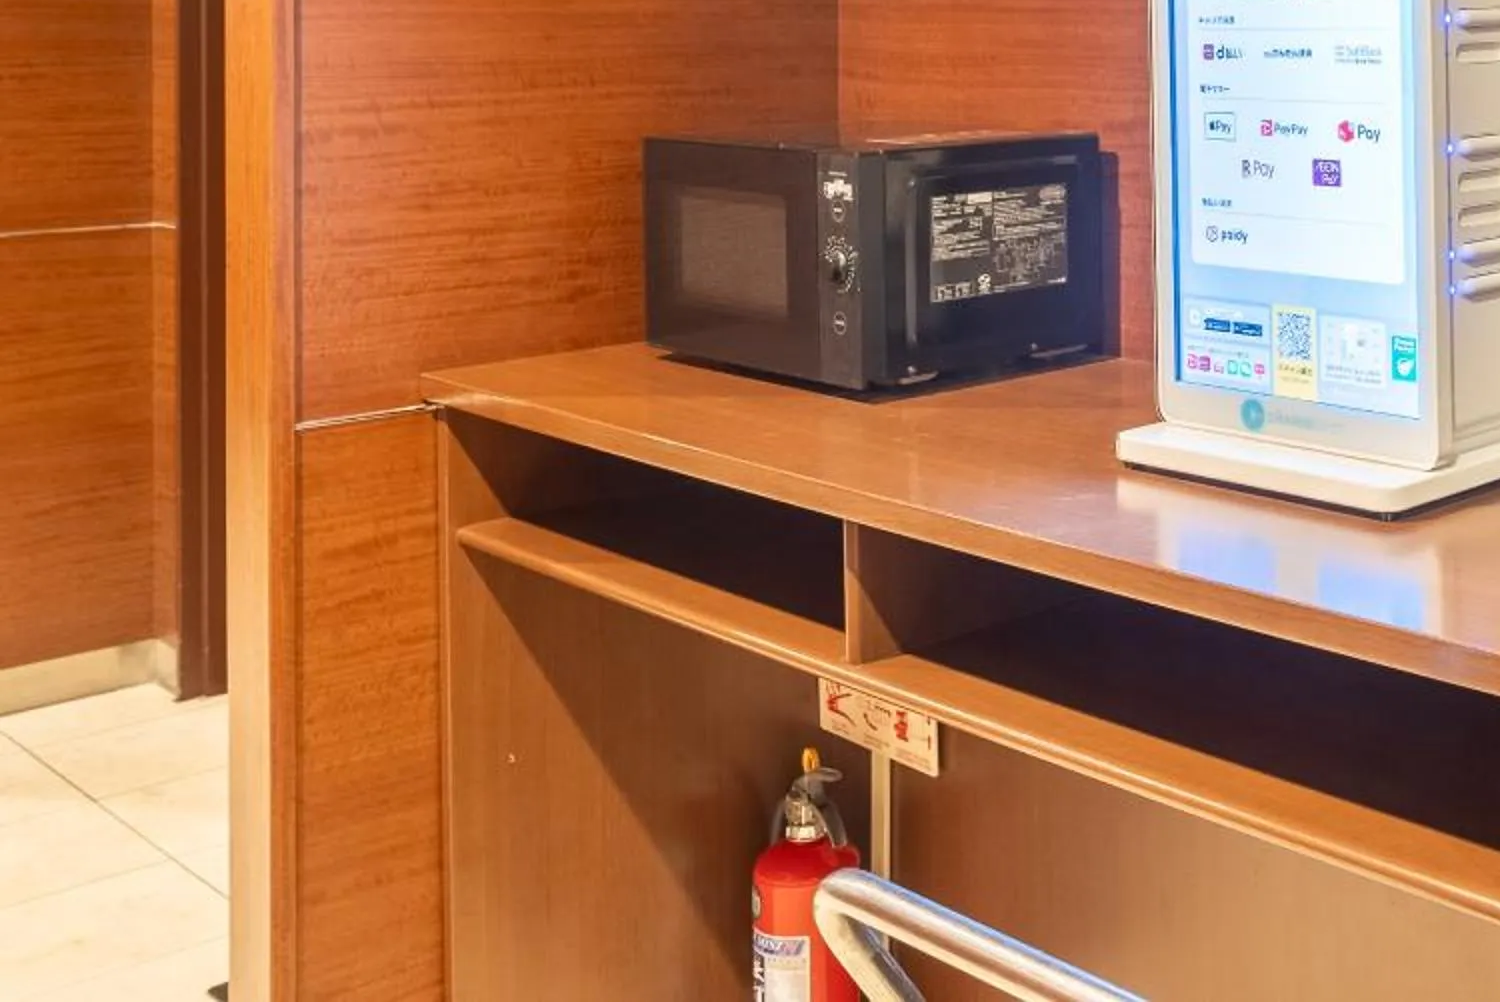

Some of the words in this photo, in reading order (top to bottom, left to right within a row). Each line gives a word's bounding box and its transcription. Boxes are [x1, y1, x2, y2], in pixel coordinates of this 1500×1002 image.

[1274, 121, 1309, 137] PayPay
[1357, 124, 1381, 143] Pay
[1221, 229, 1249, 245] paidy
